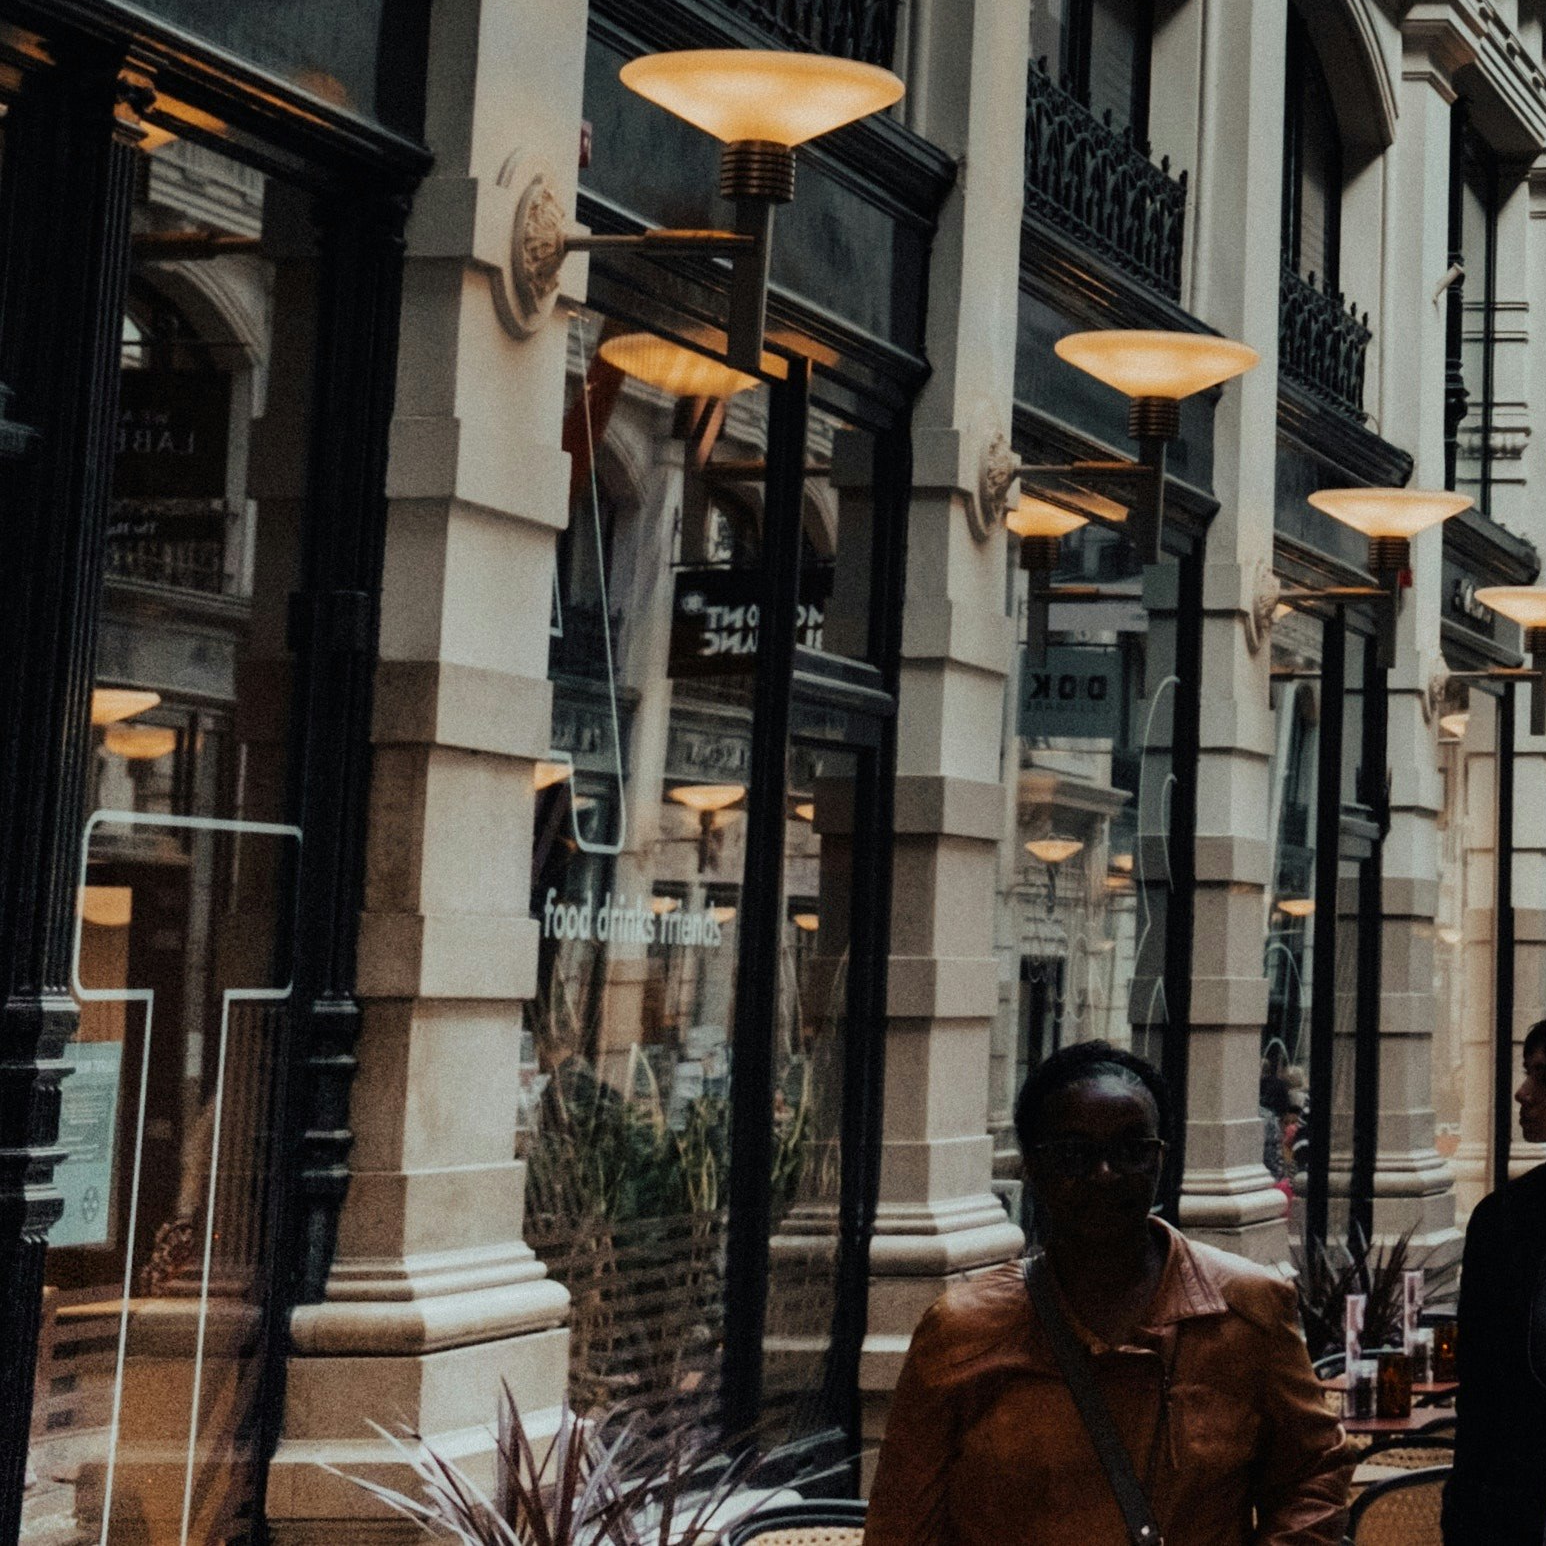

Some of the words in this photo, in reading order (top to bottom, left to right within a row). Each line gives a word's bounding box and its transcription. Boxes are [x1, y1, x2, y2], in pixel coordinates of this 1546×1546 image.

[544, 887, 592, 940] food
[597, 891, 656, 943] drinks
[661, 897, 722, 947] friends
